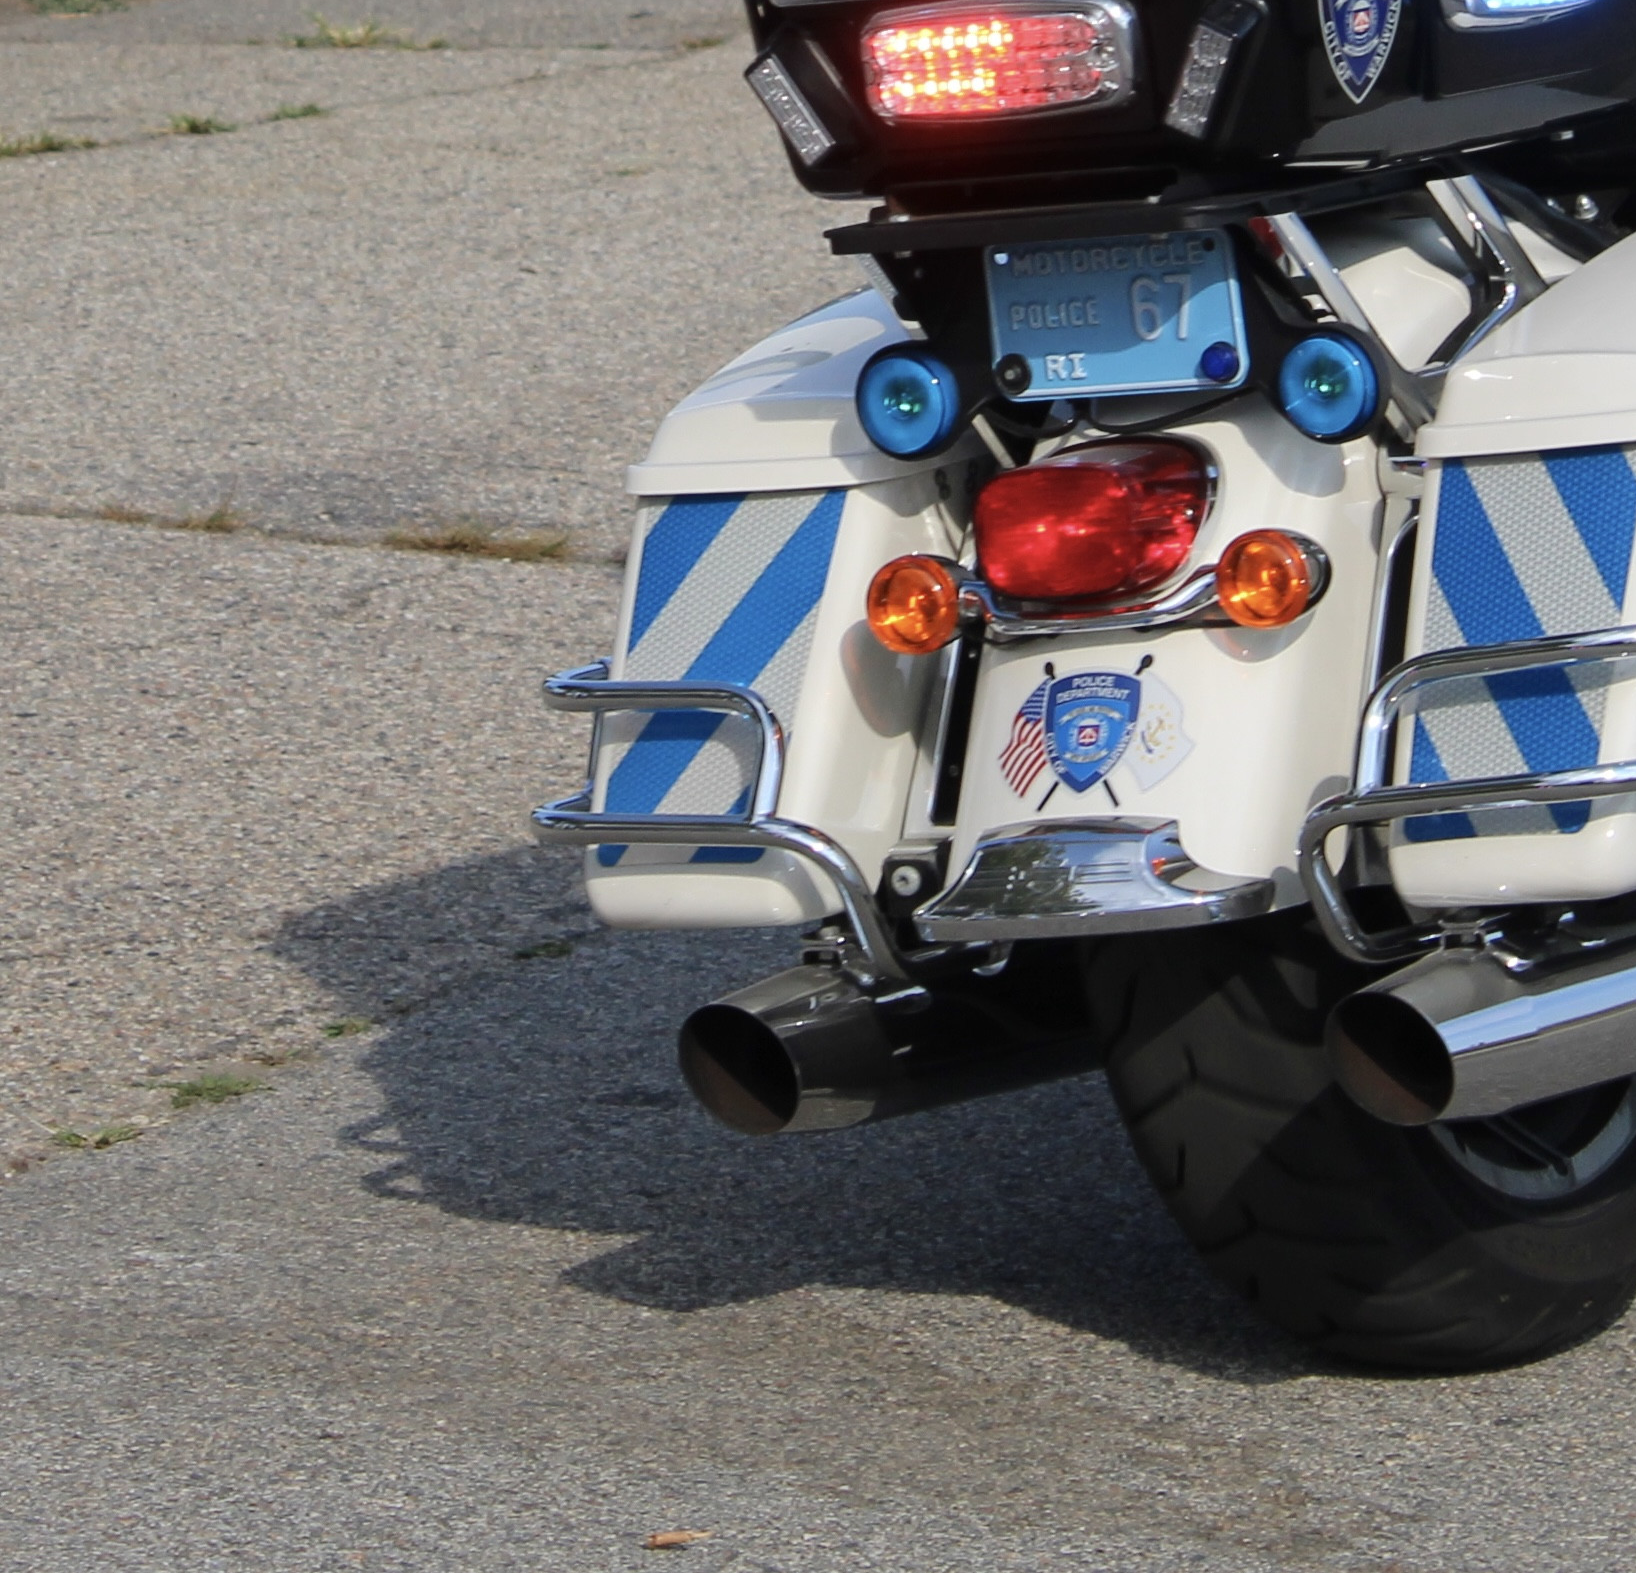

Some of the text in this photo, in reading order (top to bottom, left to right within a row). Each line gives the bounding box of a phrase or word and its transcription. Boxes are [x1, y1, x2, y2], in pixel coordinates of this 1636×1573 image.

[1324, 22, 1353, 80] CITY OF
[1364, 0, 1399, 78] WARWICK
[1012, 240, 1205, 277] MOTORCYCLE
[1010, 272, 1193, 342] POLICE 67
[1045, 352, 1088, 381] RI
[1056, 688, 1131, 704] DEPARTMENT
[1072, 676, 1116, 688] POLICE
